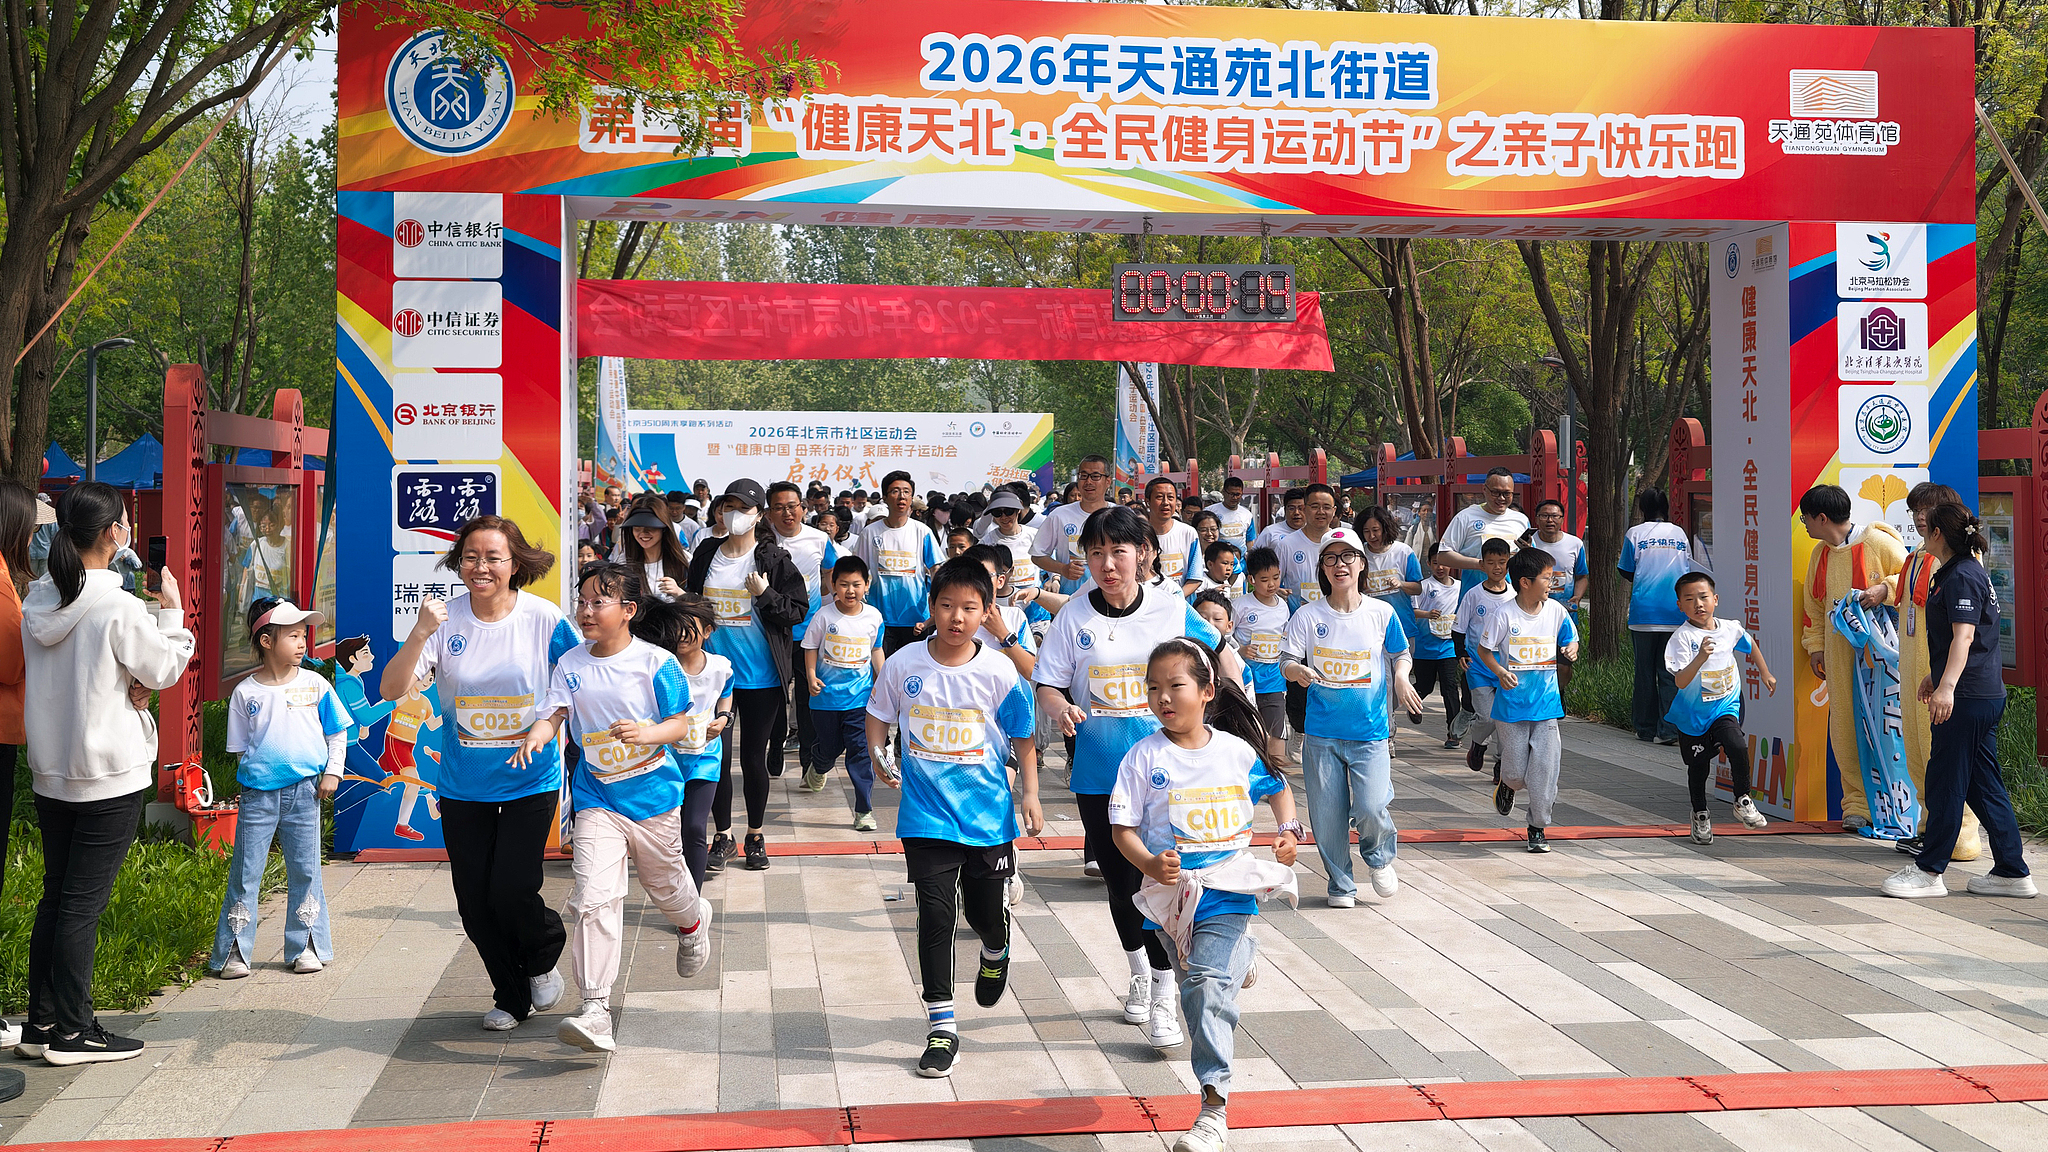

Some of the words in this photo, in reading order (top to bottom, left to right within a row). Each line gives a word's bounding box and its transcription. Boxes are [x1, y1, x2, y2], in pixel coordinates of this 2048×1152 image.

[929, 41, 1431, 102] 2026年天通苑北街道
[400, 86, 422, 127] TIAN
[422, 126, 447, 140] BEI
[449, 131, 472, 143] JIA
[474, 90, 503, 133] YUAN
[1771, 122, 1898, 142] 天通苑体育馆
[1842, 145, 1885, 153] GYMNASIUM
[427, 220, 503, 239] 中信银行
[1849, 276, 1911, 286] 北京马拉松协会
[1120, 270, 1291, 315] 00:00:14
[427, 311, 499, 328] 中信证券
[422, 403, 496, 417] 北京银行
[749, 426, 918, 440] 2026年北京市社区运动会
[786, 458, 879, 489] 启动仪式
[1741, 284, 1760, 701] 健康天北·全民健身运节
[885, 557, 909, 568] C139
[716, 600, 741, 614] 036
[832, 644, 862, 657] C128
[1258, 642, 1280, 654] C13
[1518, 647, 1549, 659] C143
[1322, 660, 1360, 675] C079
[470, 712, 523, 731] C023
[922, 723, 973, 745] C100
[598, 744, 651, 766] C023
[1186, 804, 1241, 831] C016
